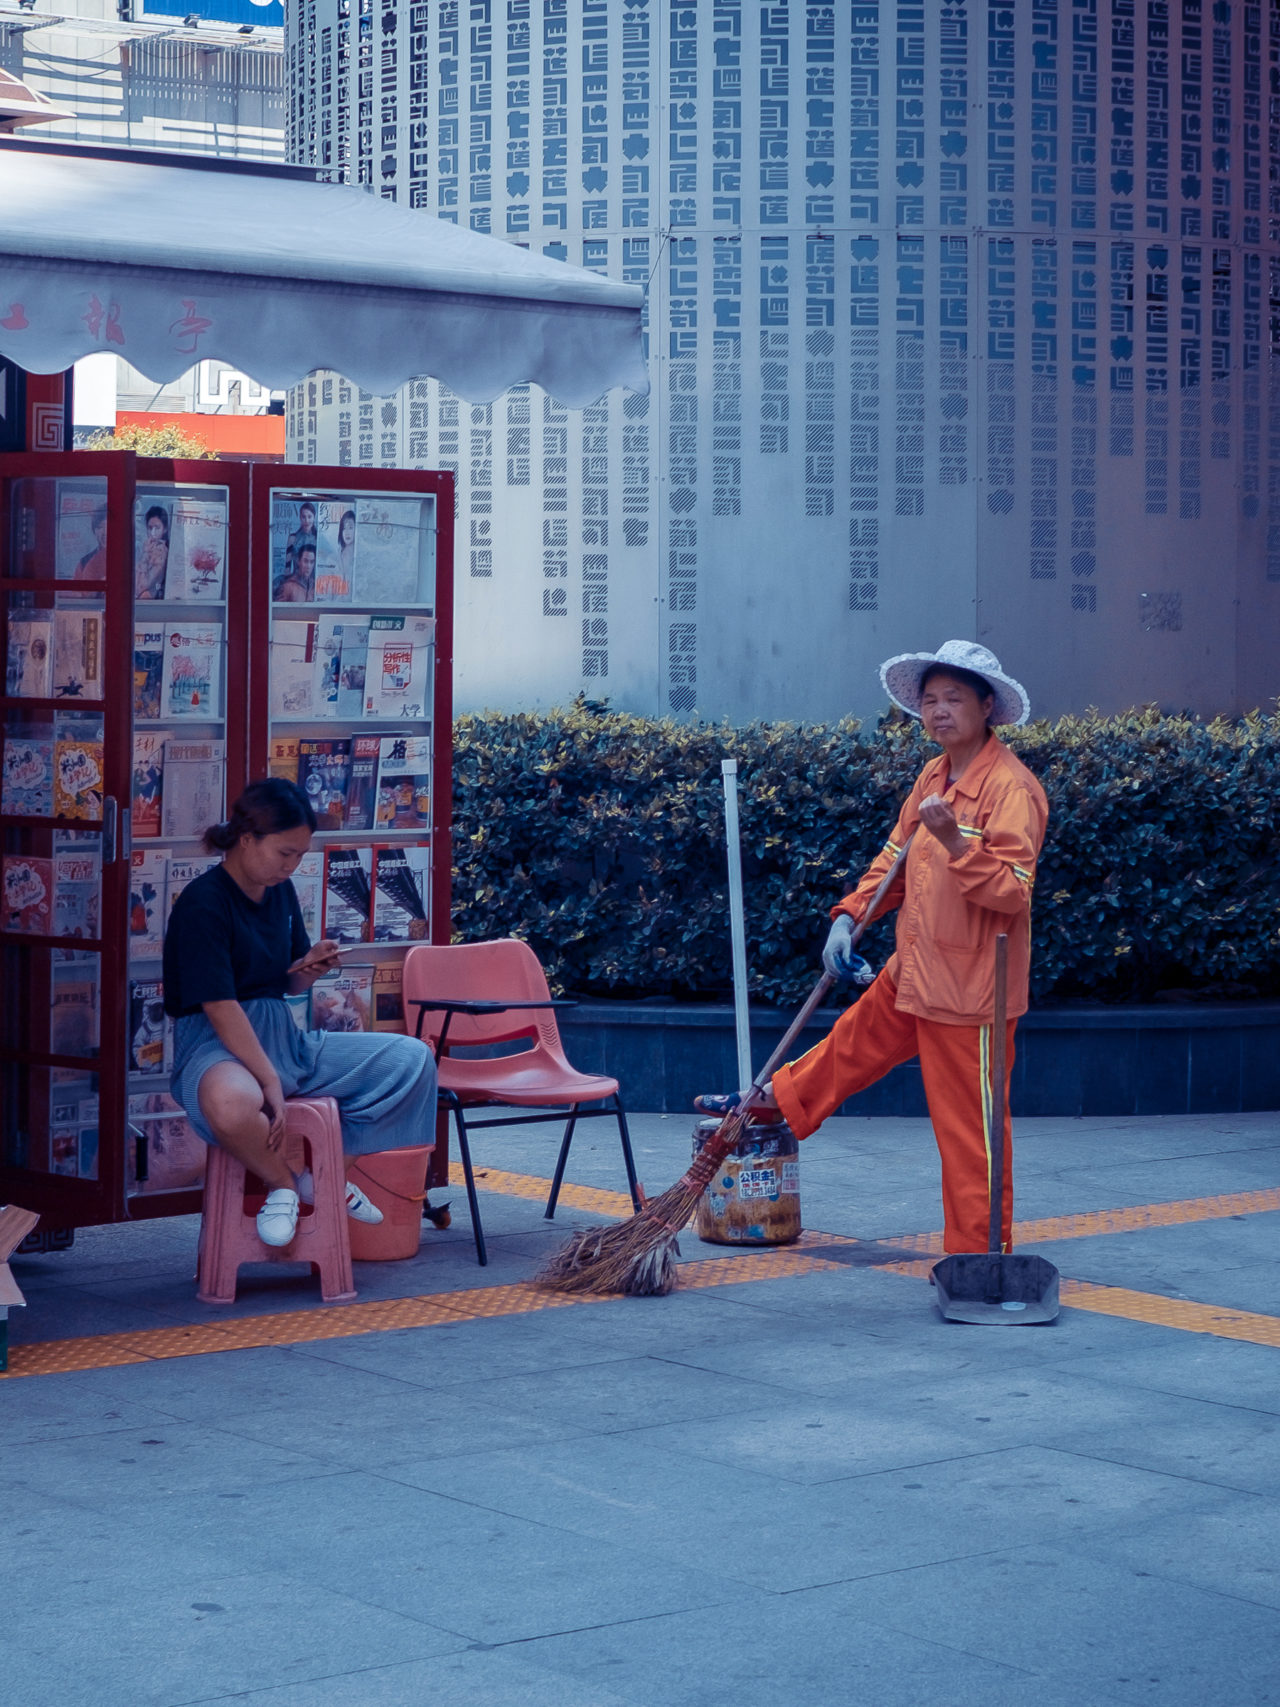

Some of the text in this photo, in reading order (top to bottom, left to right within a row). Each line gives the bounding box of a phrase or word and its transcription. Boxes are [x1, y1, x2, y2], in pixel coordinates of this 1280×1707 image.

[383, 651, 412, 664] 分析性
[383, 664, 401, 675] 写作
[400, 703, 422, 718] 大学
[740, 1170, 771, 1184] 公积金
